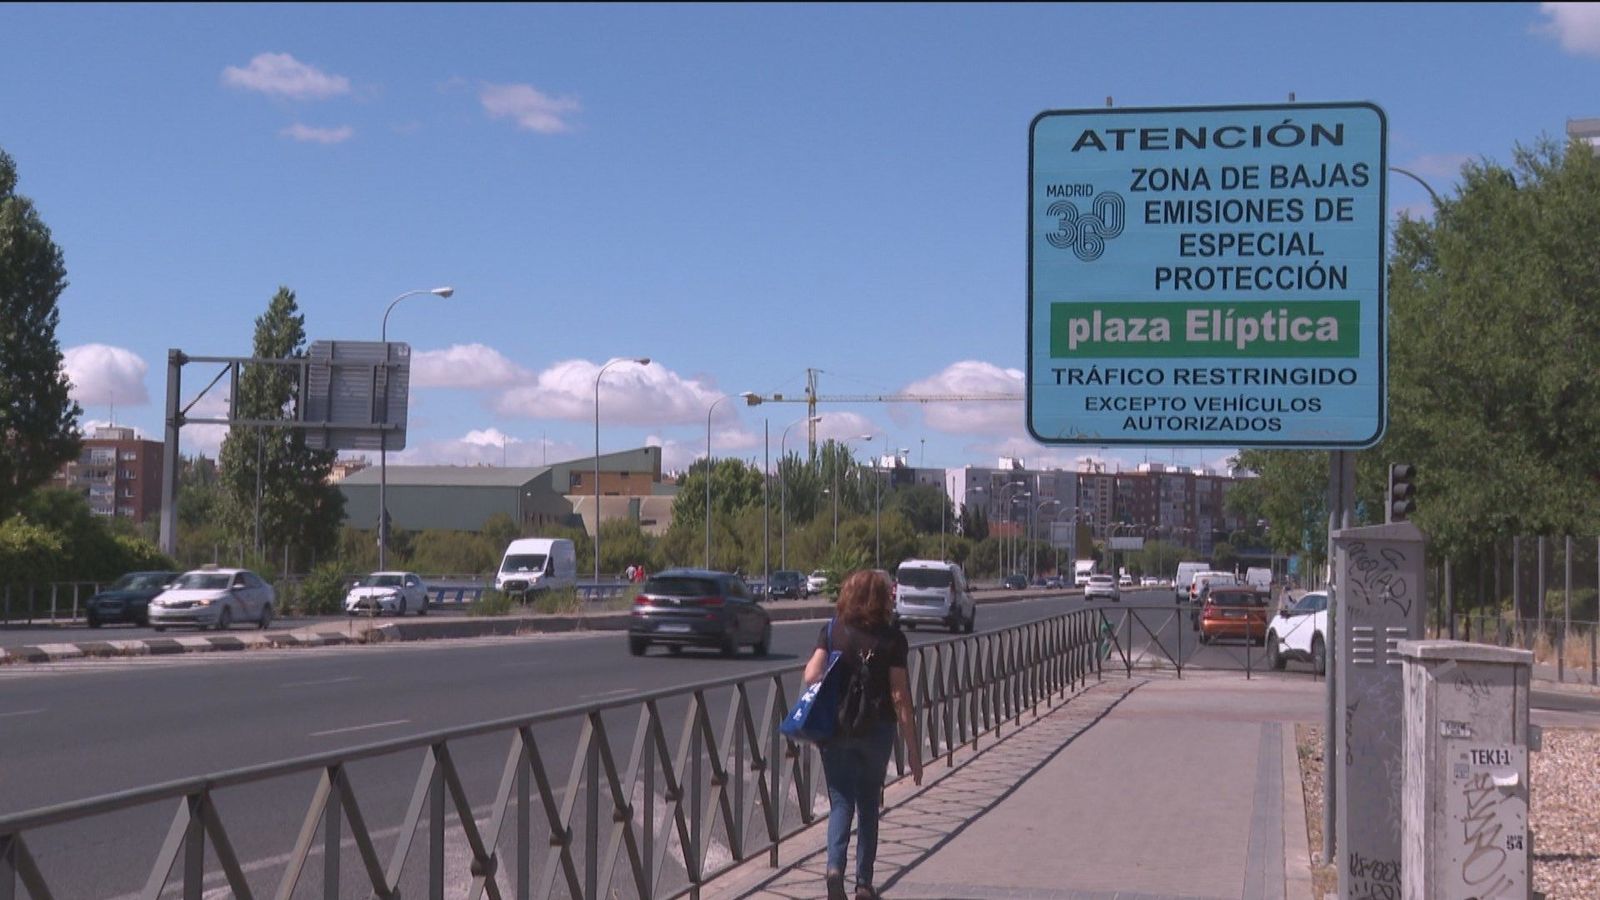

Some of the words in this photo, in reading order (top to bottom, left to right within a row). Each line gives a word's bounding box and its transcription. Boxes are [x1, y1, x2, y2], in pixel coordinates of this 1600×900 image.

[1071, 118, 1344, 152] ATENCIÓN
[1046, 183, 1094, 198] MADRID
[1130, 167, 1211, 192] ZONA
[1221, 166, 1259, 191] DE
[1270, 162, 1369, 189] BAJAS
[1144, 199, 1304, 225] EMISIONES
[1314, 198, 1354, 222] DE
[1046, 191, 1126, 262] 360
[1179, 231, 1324, 257] ESPECIAL
[1155, 260, 1348, 291] PROTECCIÓN
[1068, 310, 1170, 350] plaza
[1186, 308, 1339, 350] Elíptica
[1051, 364, 1165, 385] TRÁFICO
[1174, 367, 1357, 385] RESTRINGIDO
[1085, 397, 1187, 411] EXCEPTO
[1193, 395, 1322, 412] VEHÍCULOS
[1122, 417, 1281, 431] AUTORIZADOS
